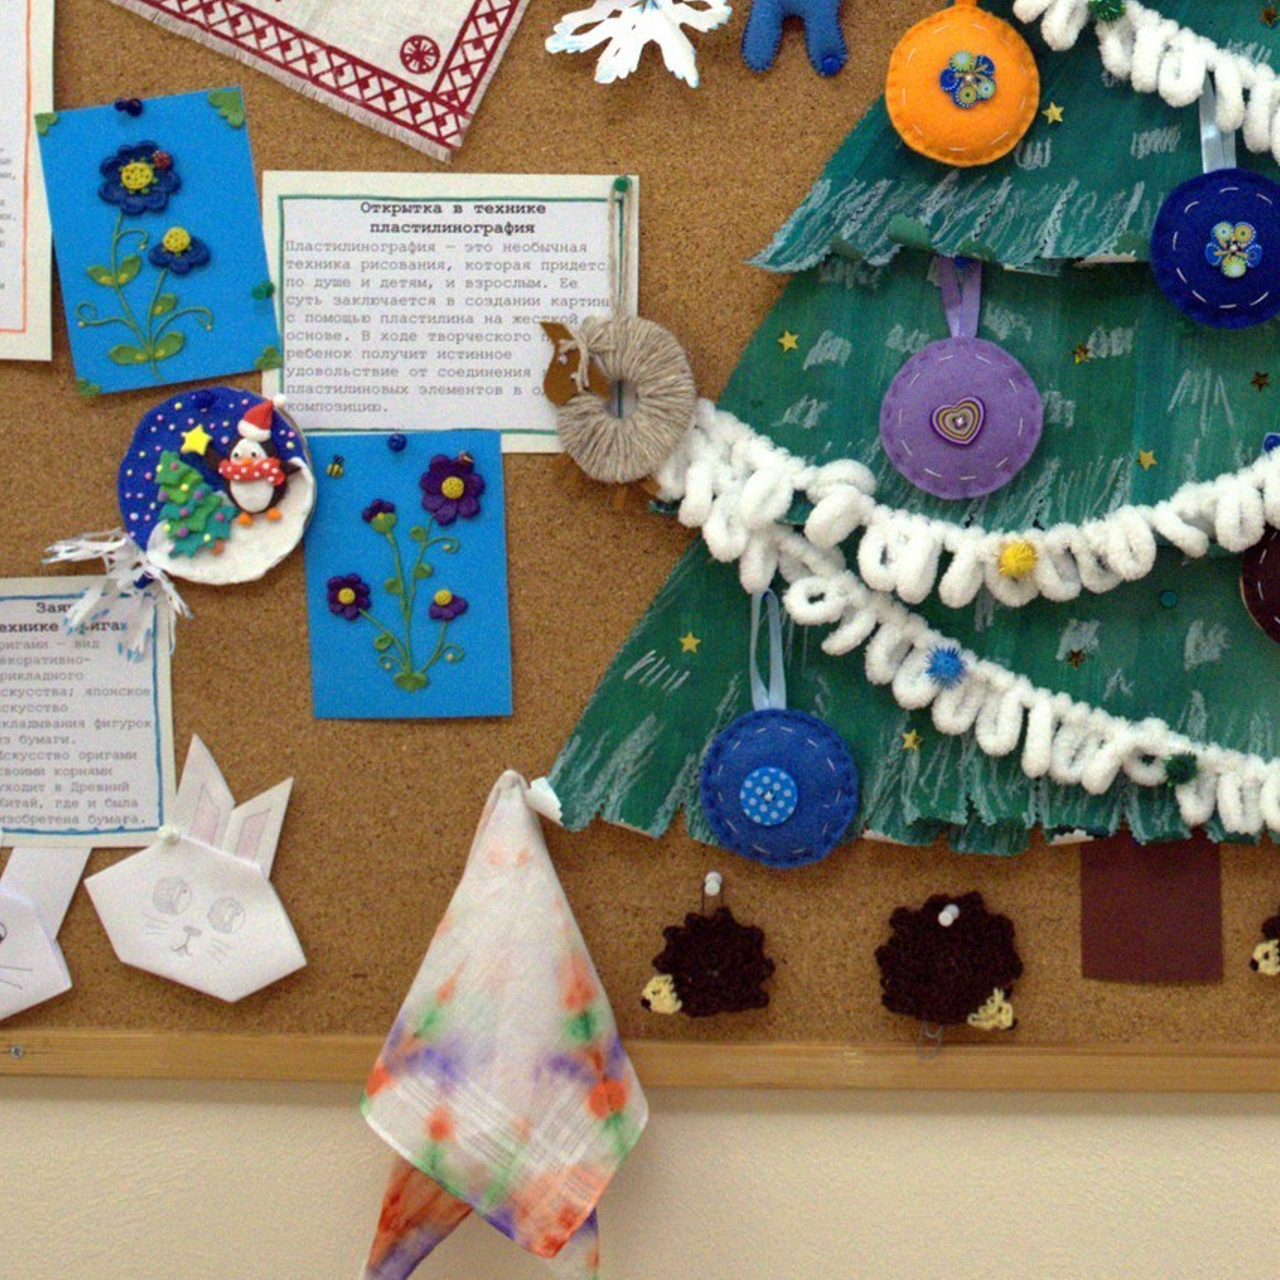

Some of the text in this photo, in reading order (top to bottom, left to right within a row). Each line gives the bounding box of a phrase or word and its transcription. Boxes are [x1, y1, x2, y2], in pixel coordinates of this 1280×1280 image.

[361, 202, 546, 217] Открытка в технике
[370, 221, 535, 236] пластилинография
[36, 602, 73, 614] Зая
